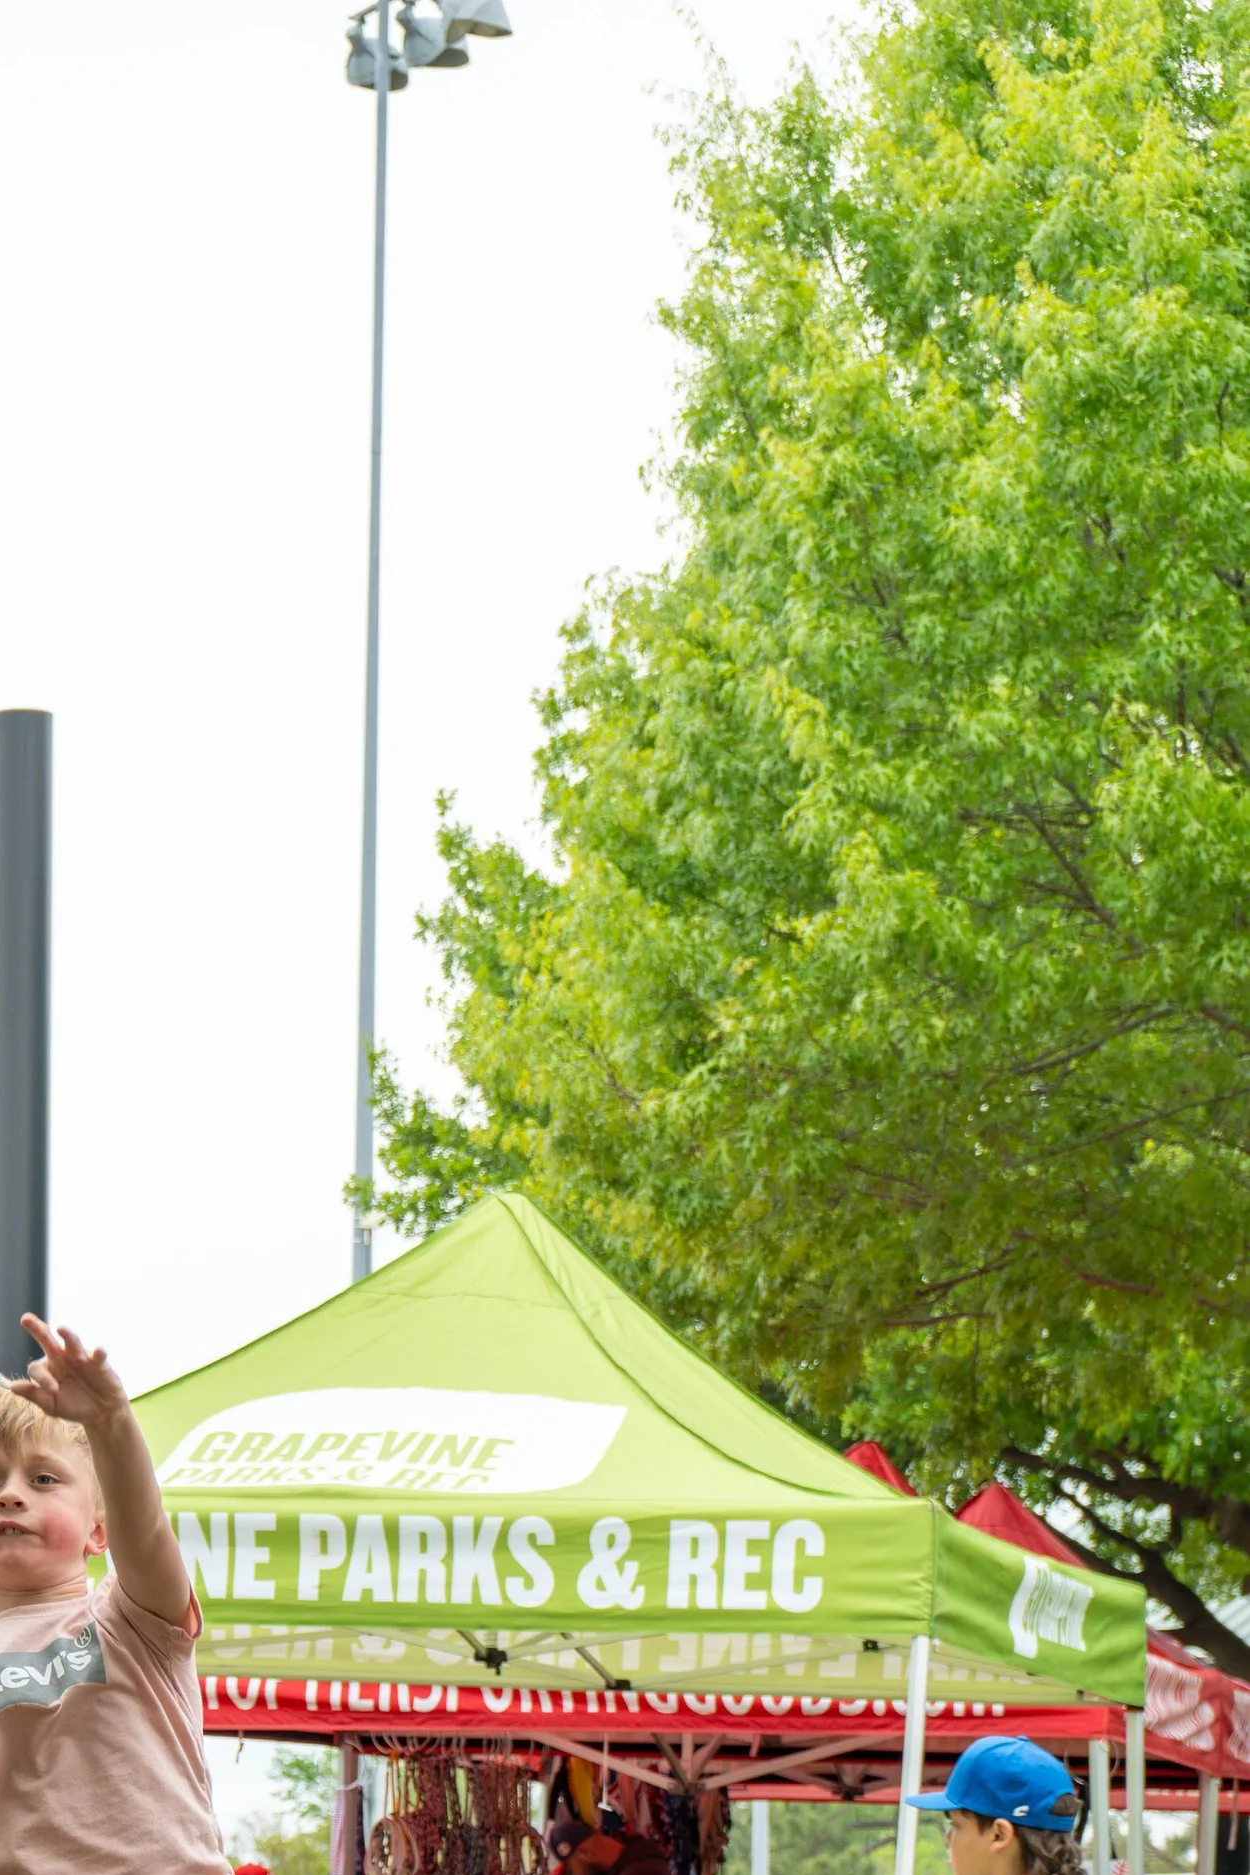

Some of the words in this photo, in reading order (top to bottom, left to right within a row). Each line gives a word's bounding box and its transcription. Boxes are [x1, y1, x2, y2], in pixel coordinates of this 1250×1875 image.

[188, 1430, 515, 1471] GRAPEVINE
[163, 1465, 324, 1485] PARKS
[296, 1512, 555, 1608] PARKS
[576, 1516, 646, 1610] &
[666, 1518, 826, 1613] REC
